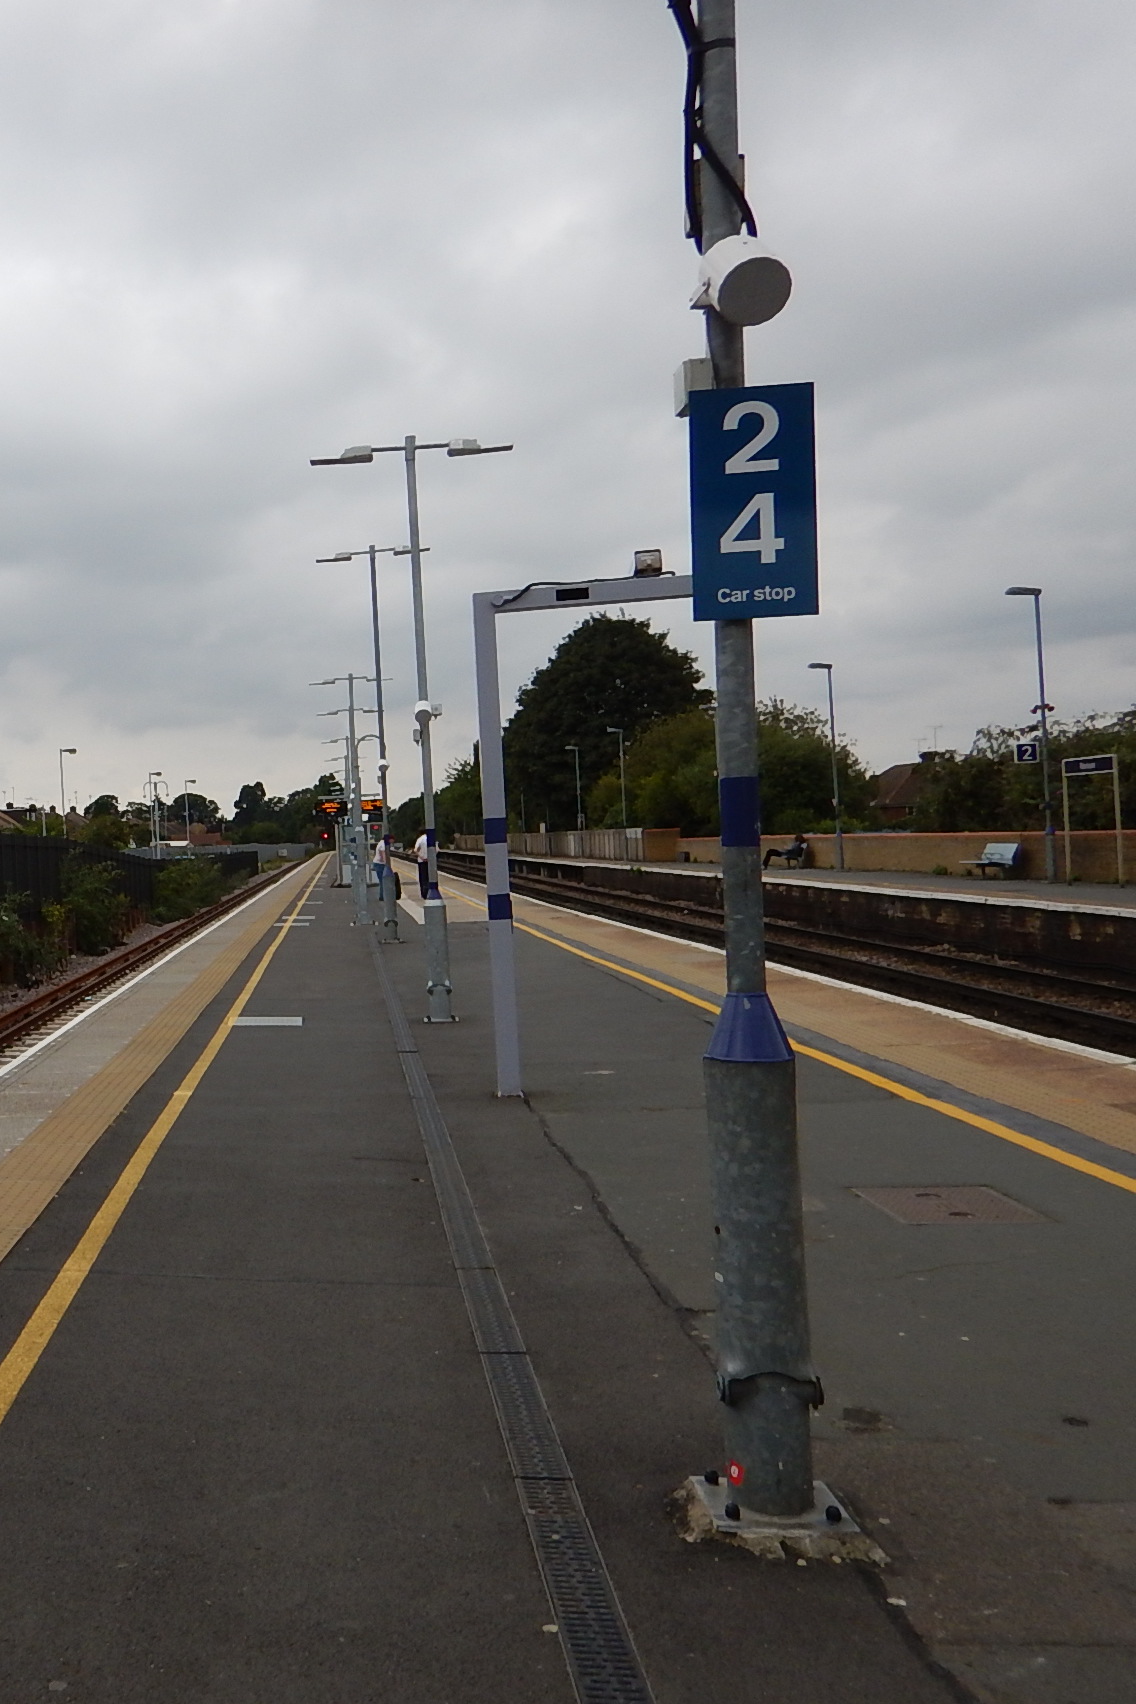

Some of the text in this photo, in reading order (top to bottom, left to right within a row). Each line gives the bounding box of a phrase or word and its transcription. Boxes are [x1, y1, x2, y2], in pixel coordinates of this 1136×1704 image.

[722, 400, 780, 475] 2
[719, 492, 785, 564] 4
[717, 585, 796, 603] Car stop
[1021, 745, 1033, 760] 2
